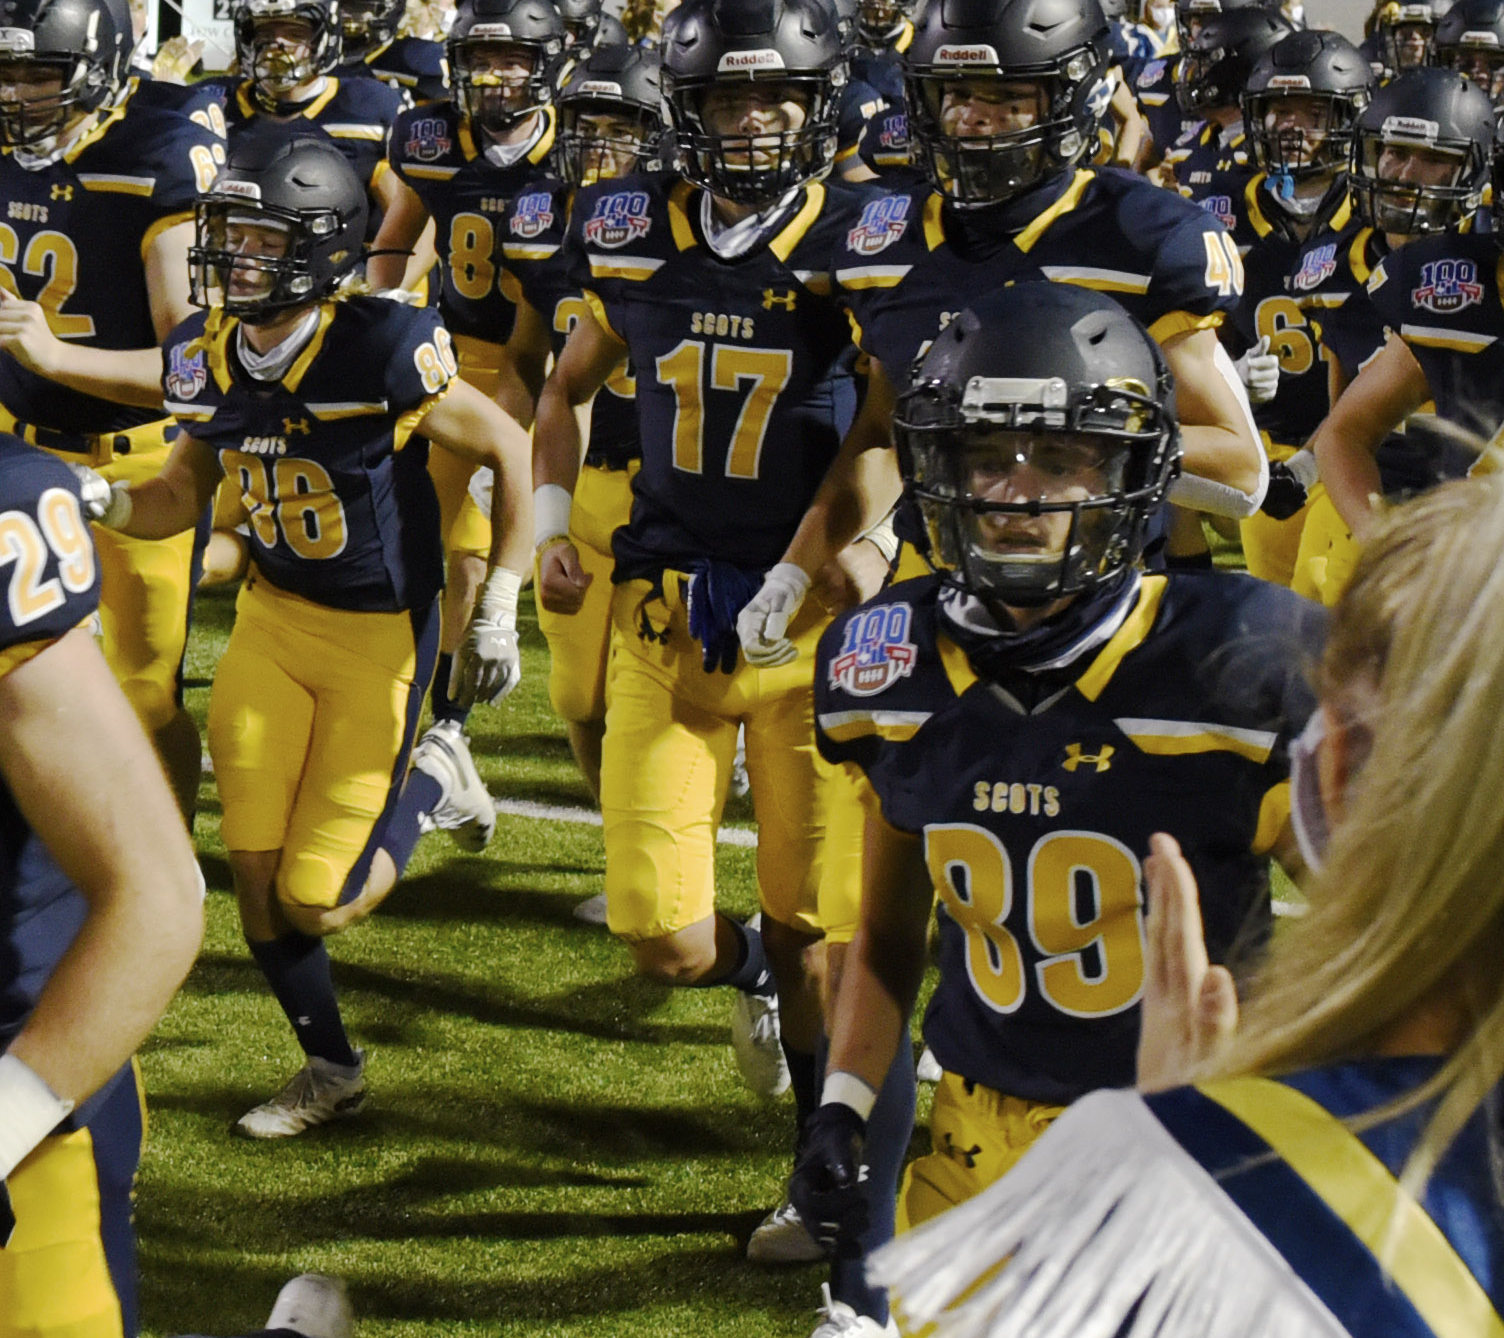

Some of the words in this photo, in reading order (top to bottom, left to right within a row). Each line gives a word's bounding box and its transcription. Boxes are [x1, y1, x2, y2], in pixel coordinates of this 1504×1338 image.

[940, 48, 987, 63] Riddell
[7, 200, 50, 224] SCOTS
[516, 191, 553, 217] 100
[595, 191, 650, 218] 100
[862, 194, 912, 225] 100
[1304, 242, 1339, 266] 100
[1421, 259, 1476, 287] 100
[690, 311, 755, 340] SCOTS
[412, 325, 459, 396] 86
[654, 340, 793, 480] 17
[239, 434, 288, 456] SCOTS
[844, 600, 912, 652] 100
[972, 779, 1061, 818] SCOTS
[922, 822, 1149, 1020] 89
